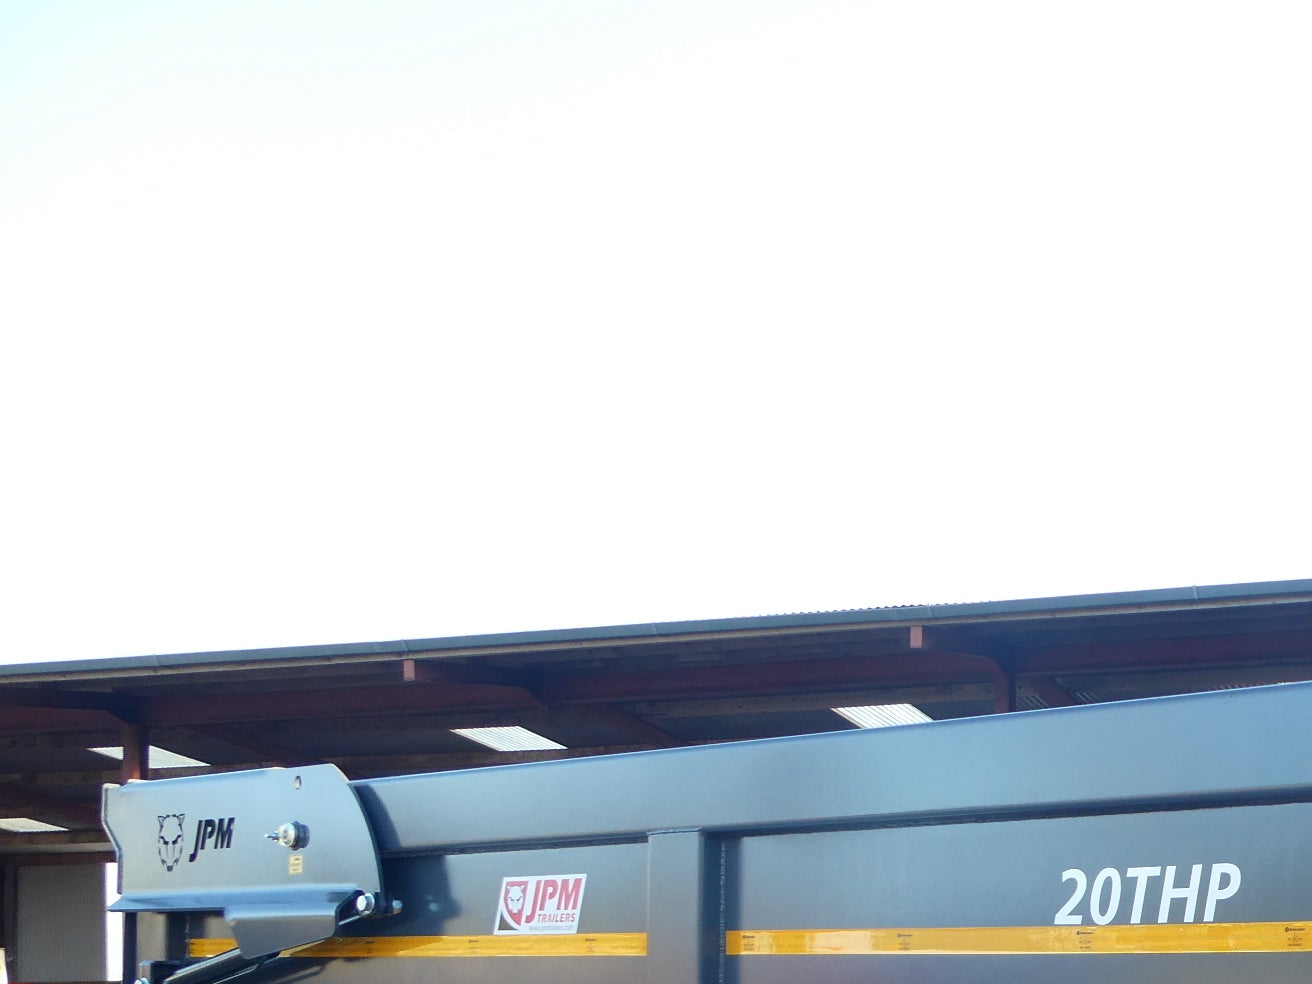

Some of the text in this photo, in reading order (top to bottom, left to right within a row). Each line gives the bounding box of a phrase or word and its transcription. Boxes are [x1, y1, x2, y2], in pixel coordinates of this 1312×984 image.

[188, 817, 235, 862] JPM
[525, 878, 583, 924] JPM
[1053, 862, 1242, 926] 20THP
[537, 912, 576, 923] TRAILERS
